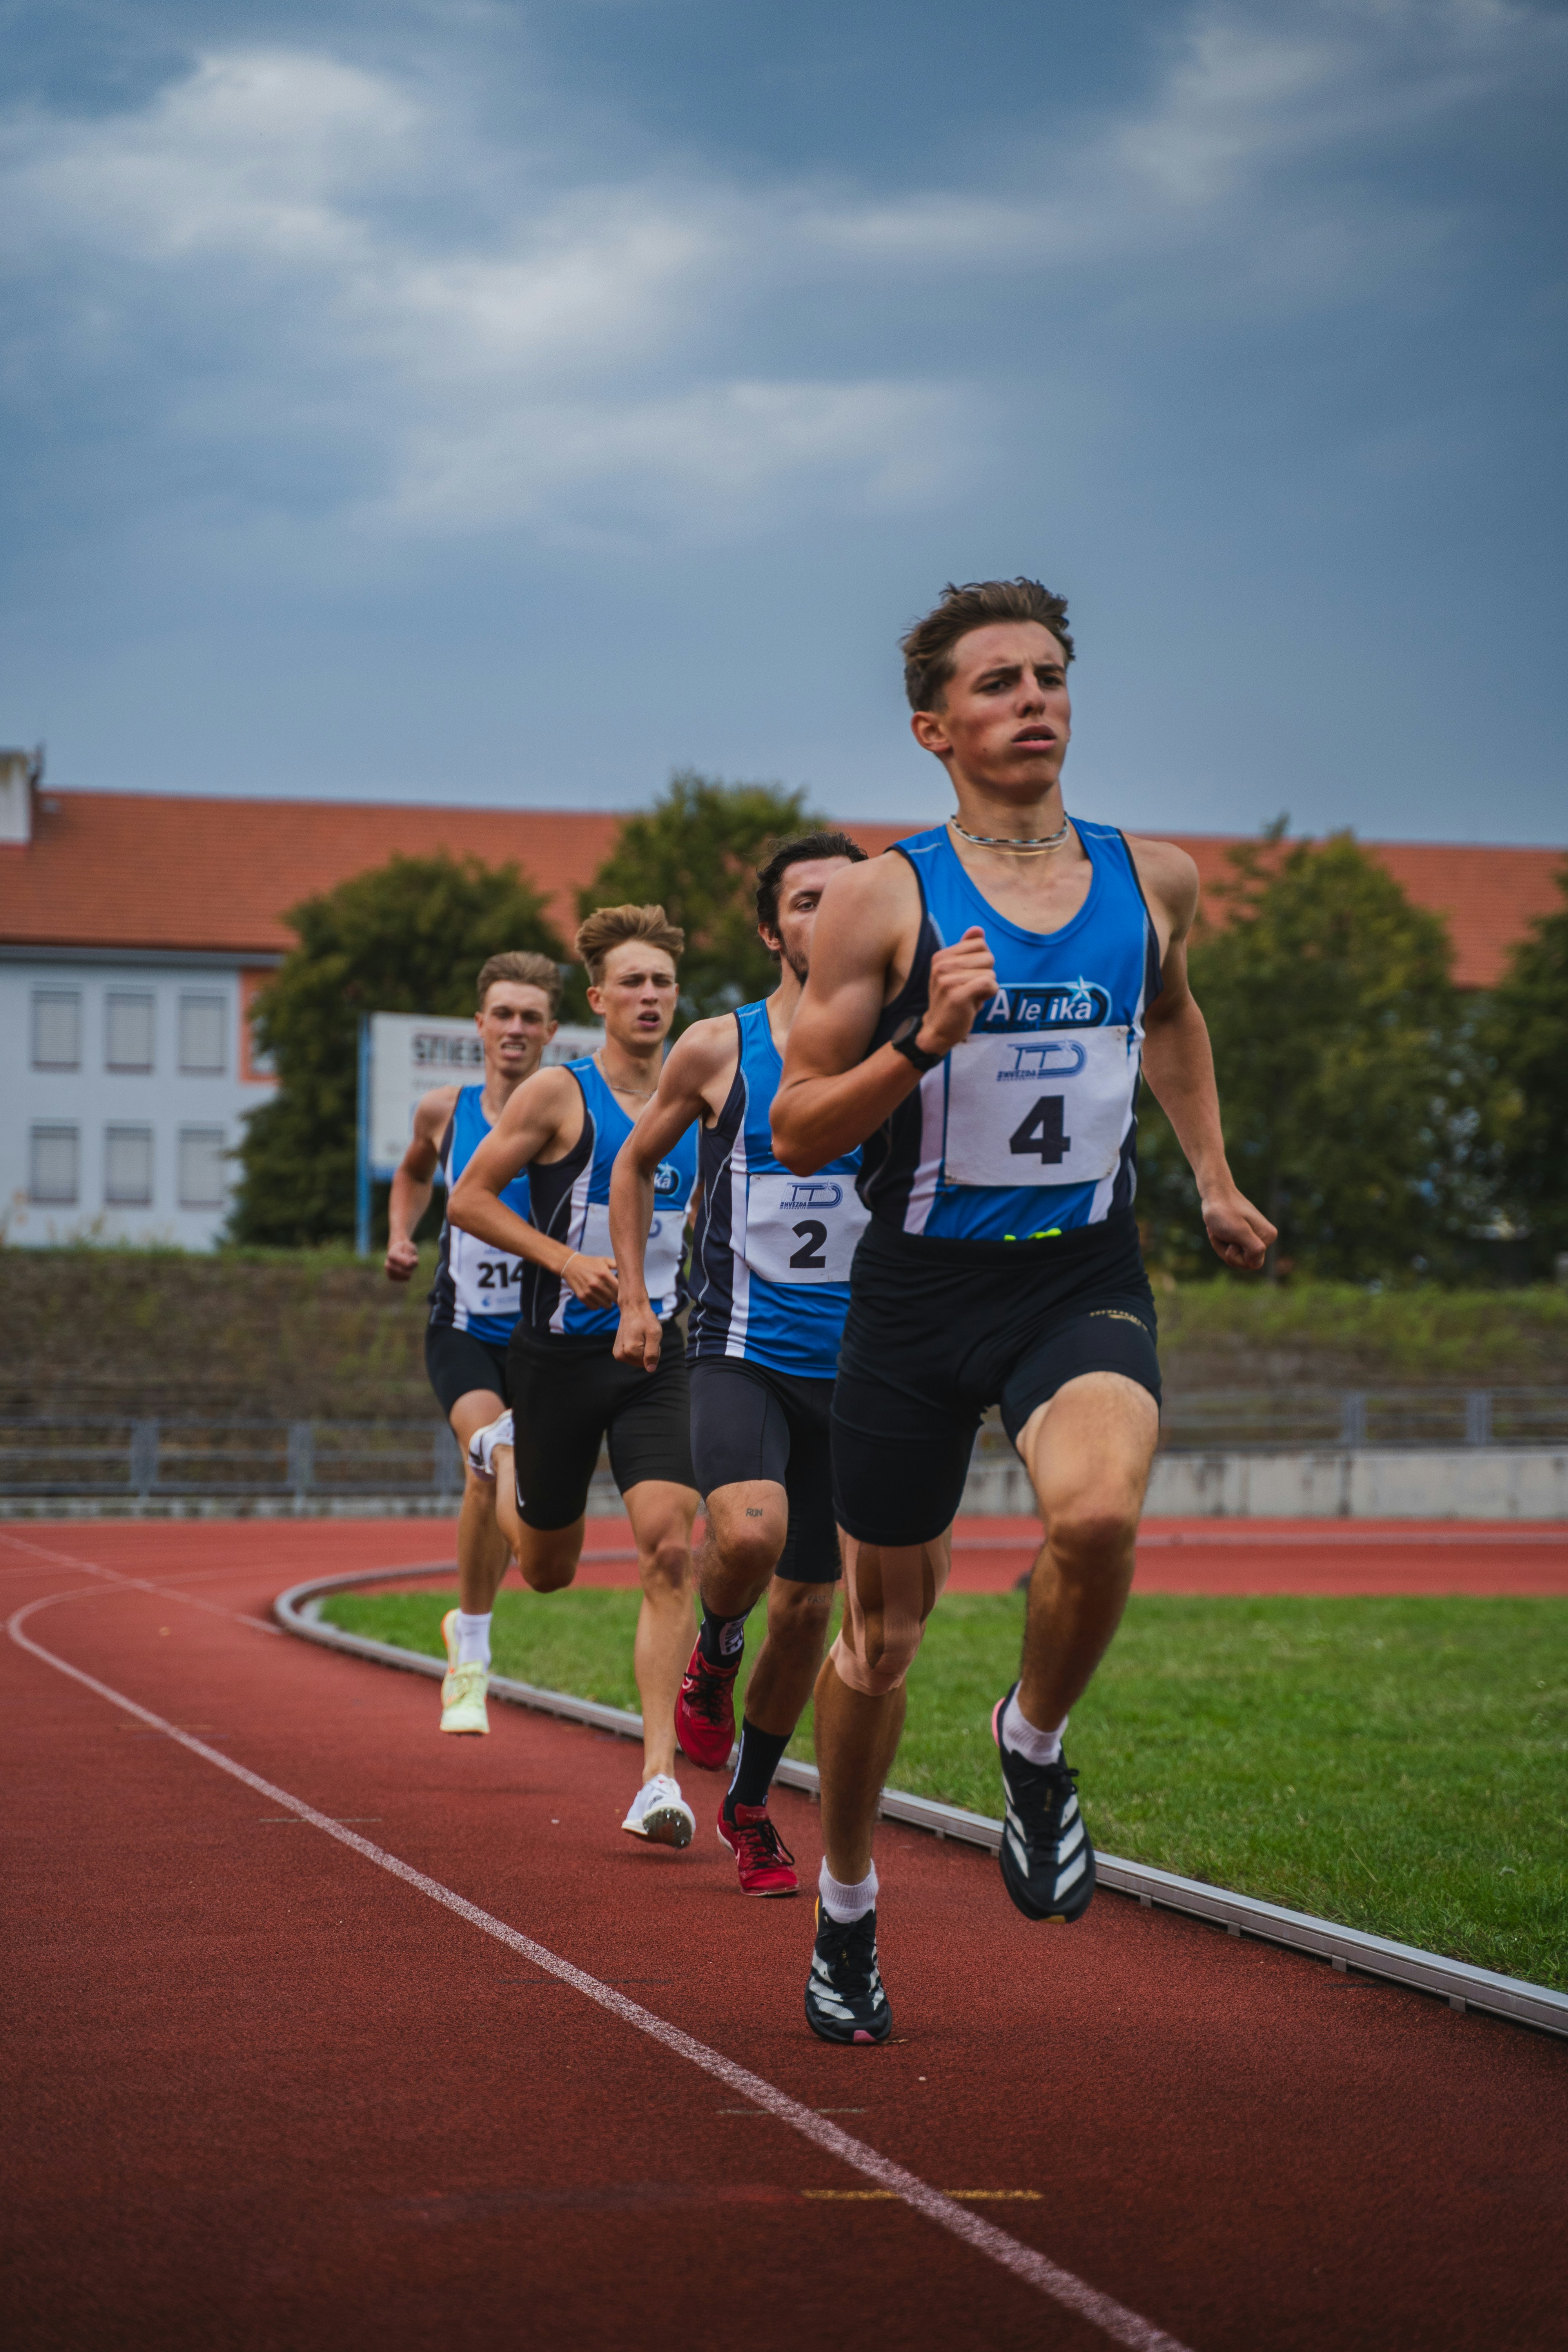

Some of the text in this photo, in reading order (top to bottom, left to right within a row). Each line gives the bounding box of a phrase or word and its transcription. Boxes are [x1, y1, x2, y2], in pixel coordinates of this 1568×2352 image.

[1009, 1095, 1071, 1164] 4
[789, 1220, 828, 1269] 2
[477, 1261, 523, 1289] 214
[746, 1508, 763, 1517] RUN
